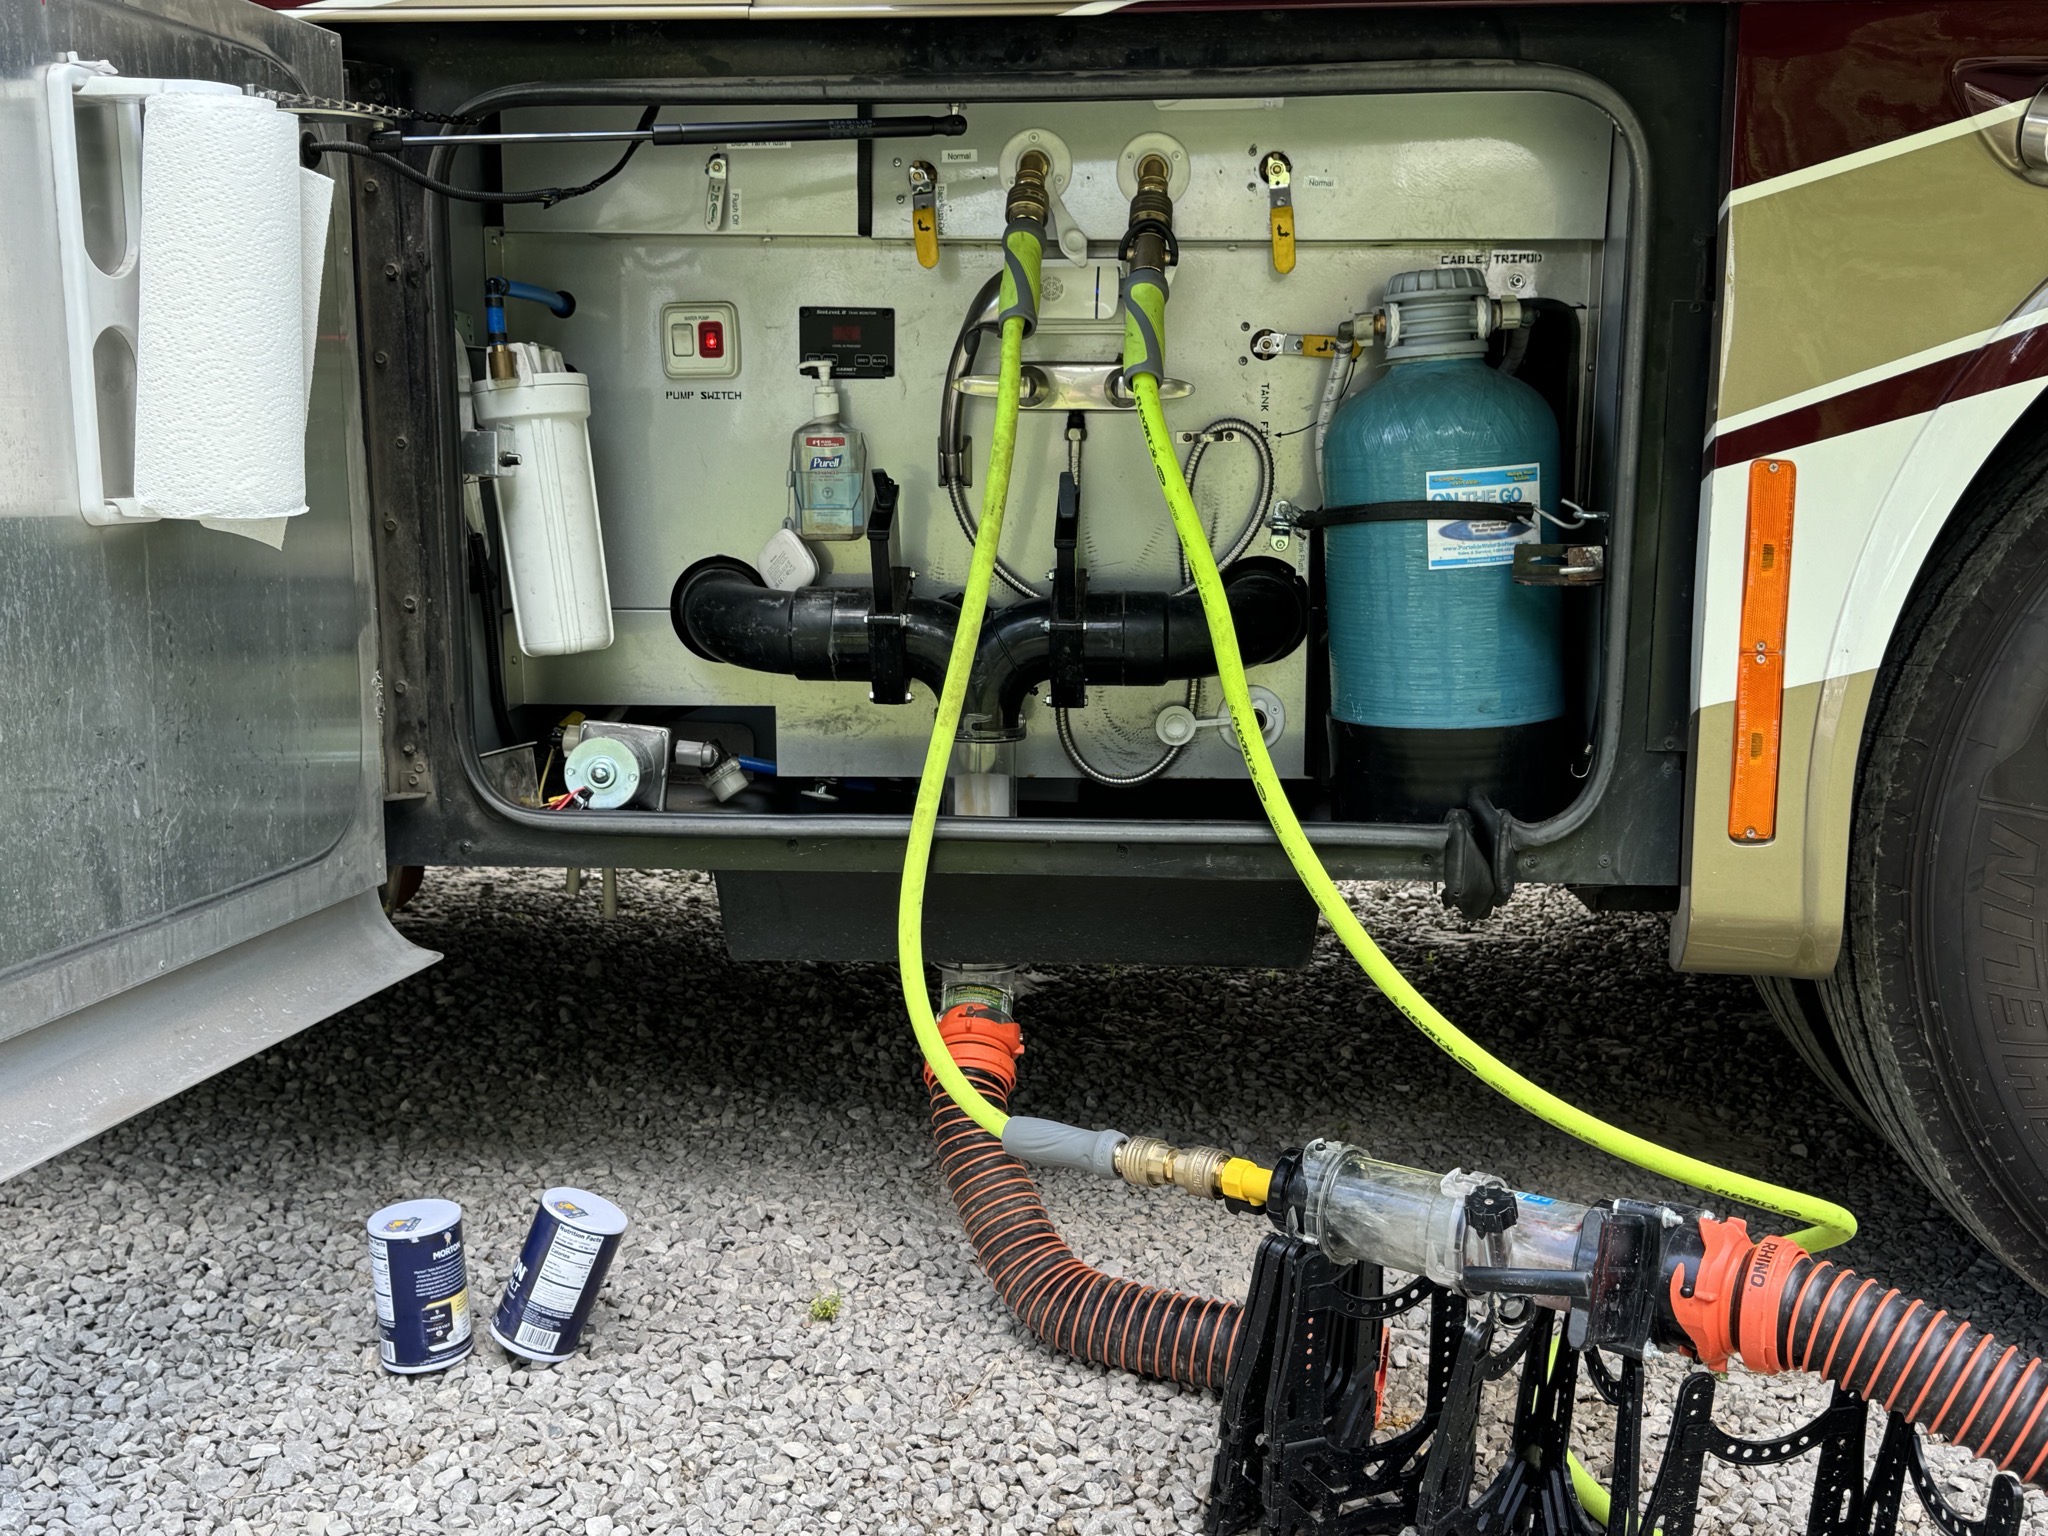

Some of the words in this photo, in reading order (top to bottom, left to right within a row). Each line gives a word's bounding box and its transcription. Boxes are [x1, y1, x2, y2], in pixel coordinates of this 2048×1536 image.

[947, 152, 971, 160] Normal
[1308, 179, 1334, 187] Normal
[1441, 255, 1483, 265] CABLE
[1493, 253, 1542, 264] TRIPOD
[665, 391, 694, 400] PUMP
[700, 391, 742, 400] SWITCH
[1260, 382, 1270, 412] TANK
[813, 457, 840, 468] Purell
[1500, 486, 1523, 503] GO
[1233, 716, 1258, 776] FLEXZILLA
[1270, 814, 1283, 835] WATER
[1401, 1005, 1454, 1053] FLEXZILLA
[1490, 1080, 1511, 1096] WATER
[1717, 1188, 1779, 1211] FLEXZILLA
[559, 1225, 585, 1240] Nutrition
[432, 1240, 461, 1260] MORTON
[1750, 1241, 1779, 1288] RHINO
